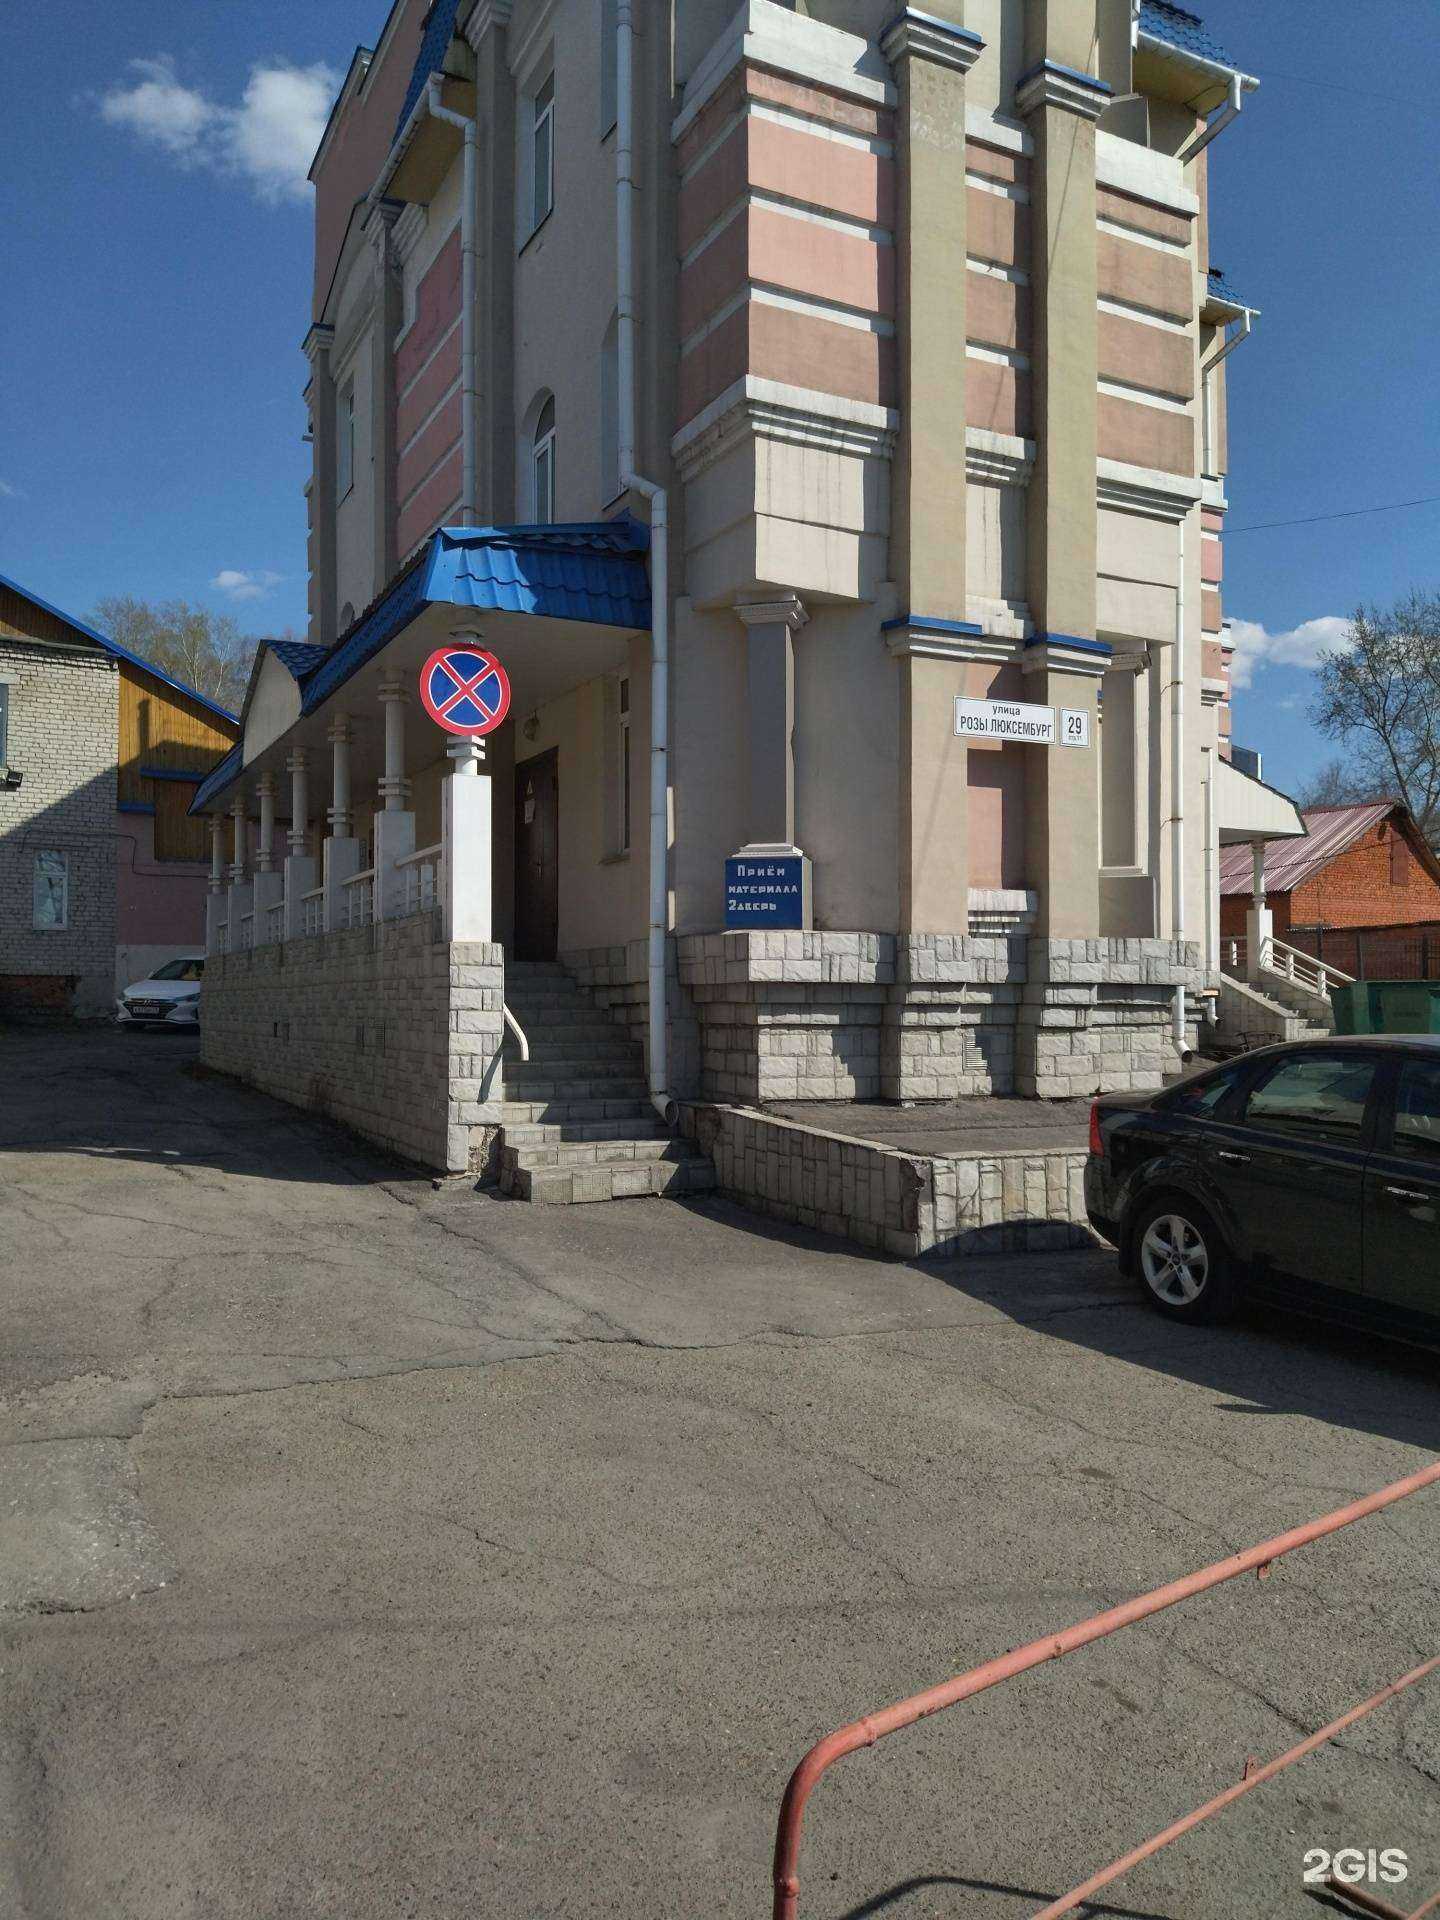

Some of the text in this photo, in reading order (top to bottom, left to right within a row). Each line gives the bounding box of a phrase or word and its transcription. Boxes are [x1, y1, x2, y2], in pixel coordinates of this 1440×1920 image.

[992, 705, 1021, 716] улица
[960, 716, 1052, 738] РОЗЫ ЛЮКСЕМБУРГ
[1068, 716, 1082, 735] 29
